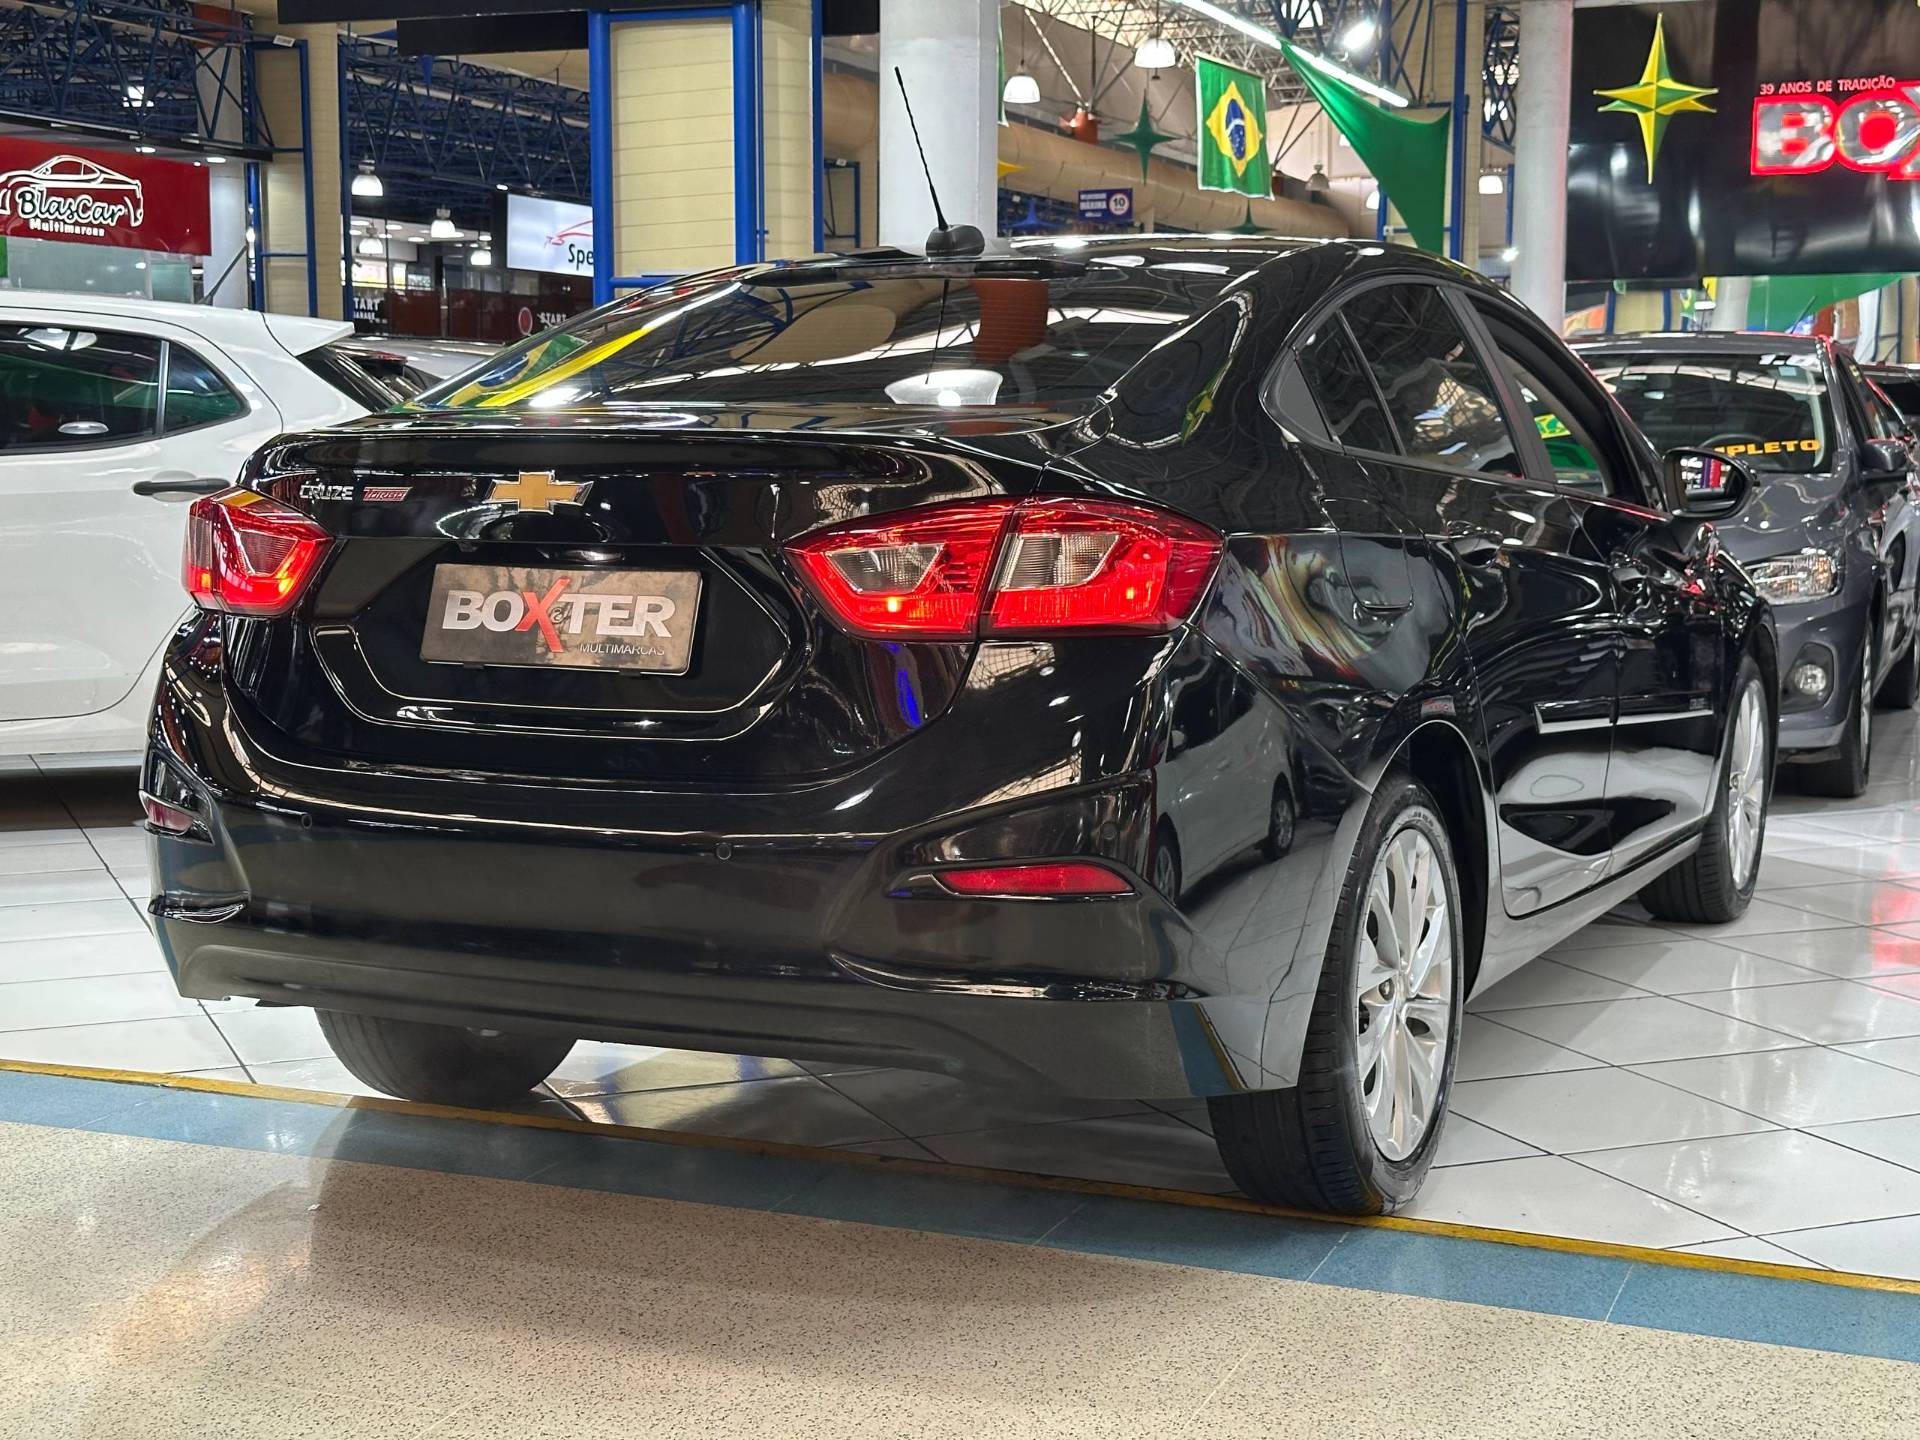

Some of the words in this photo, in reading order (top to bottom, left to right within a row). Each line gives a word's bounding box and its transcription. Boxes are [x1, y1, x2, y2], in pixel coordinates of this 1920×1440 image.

[1759, 83, 1775, 95] 39
[1778, 81, 1812, 94] ANOS
[1816, 79, 1833, 93] DE
[1837, 74, 1896, 91] TRADIÇÃO
[16, 186, 125, 226] BlasCar
[1113, 197, 1126, 208] 10
[353, 297, 381, 311] TART
[1713, 439, 1821, 457] PLETO
[299, 483, 354, 501] CRUZE
[442, 576, 677, 653] BOXTER
[579, 643, 666, 656] MULTIMARCAS
